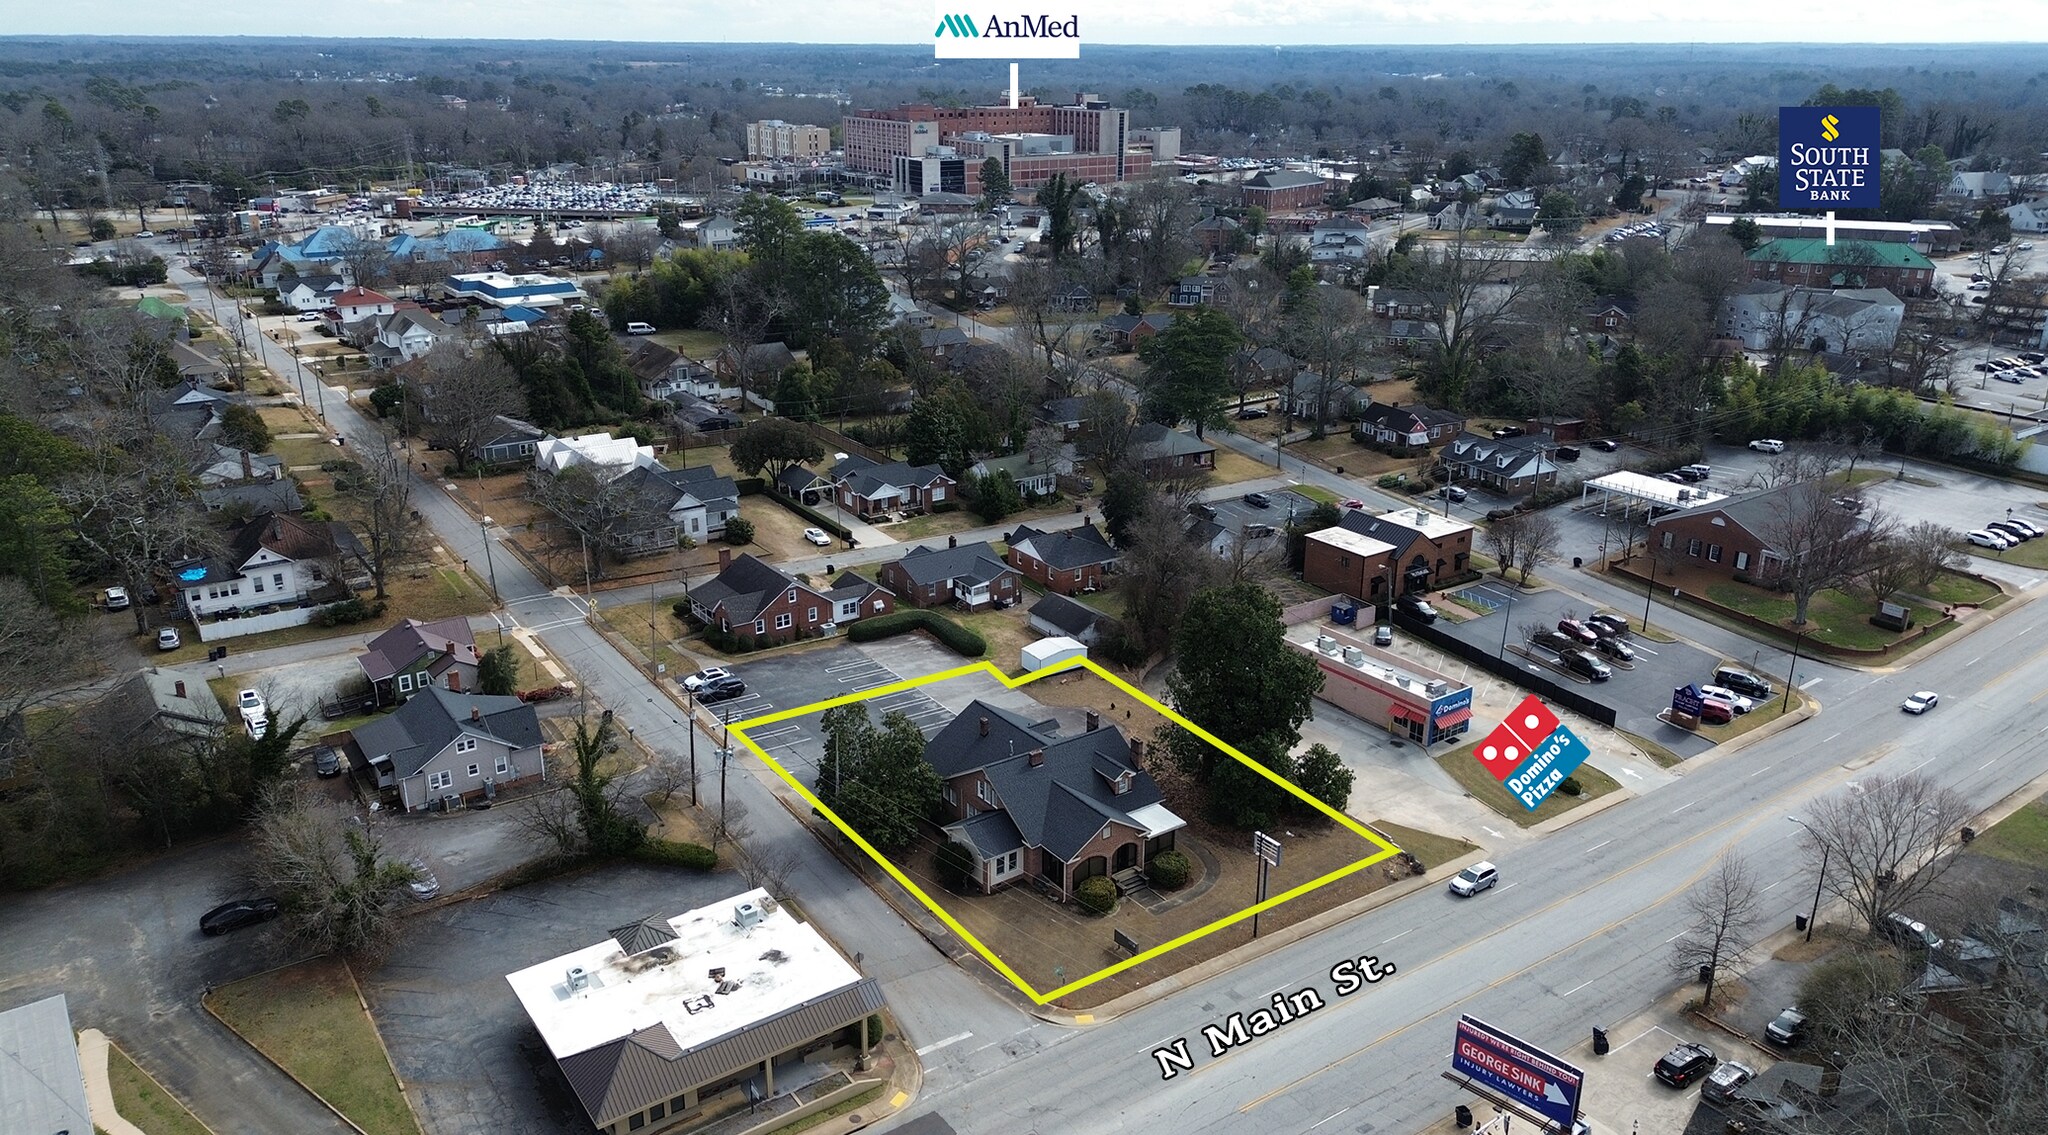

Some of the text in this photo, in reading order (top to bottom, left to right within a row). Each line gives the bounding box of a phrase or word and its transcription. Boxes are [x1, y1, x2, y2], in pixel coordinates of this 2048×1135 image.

[1459, 1023, 1489, 1042] INJURED?
[1511, 1049, 1530, 1062] RIGHT
[1531, 1058, 1557, 1075] BEHIND
[1462, 1043, 1541, 1092] GEORGE SINK
[1460, 1058, 1493, 1078] INJURY
[1496, 1076, 1539, 1102] LAWYERS
